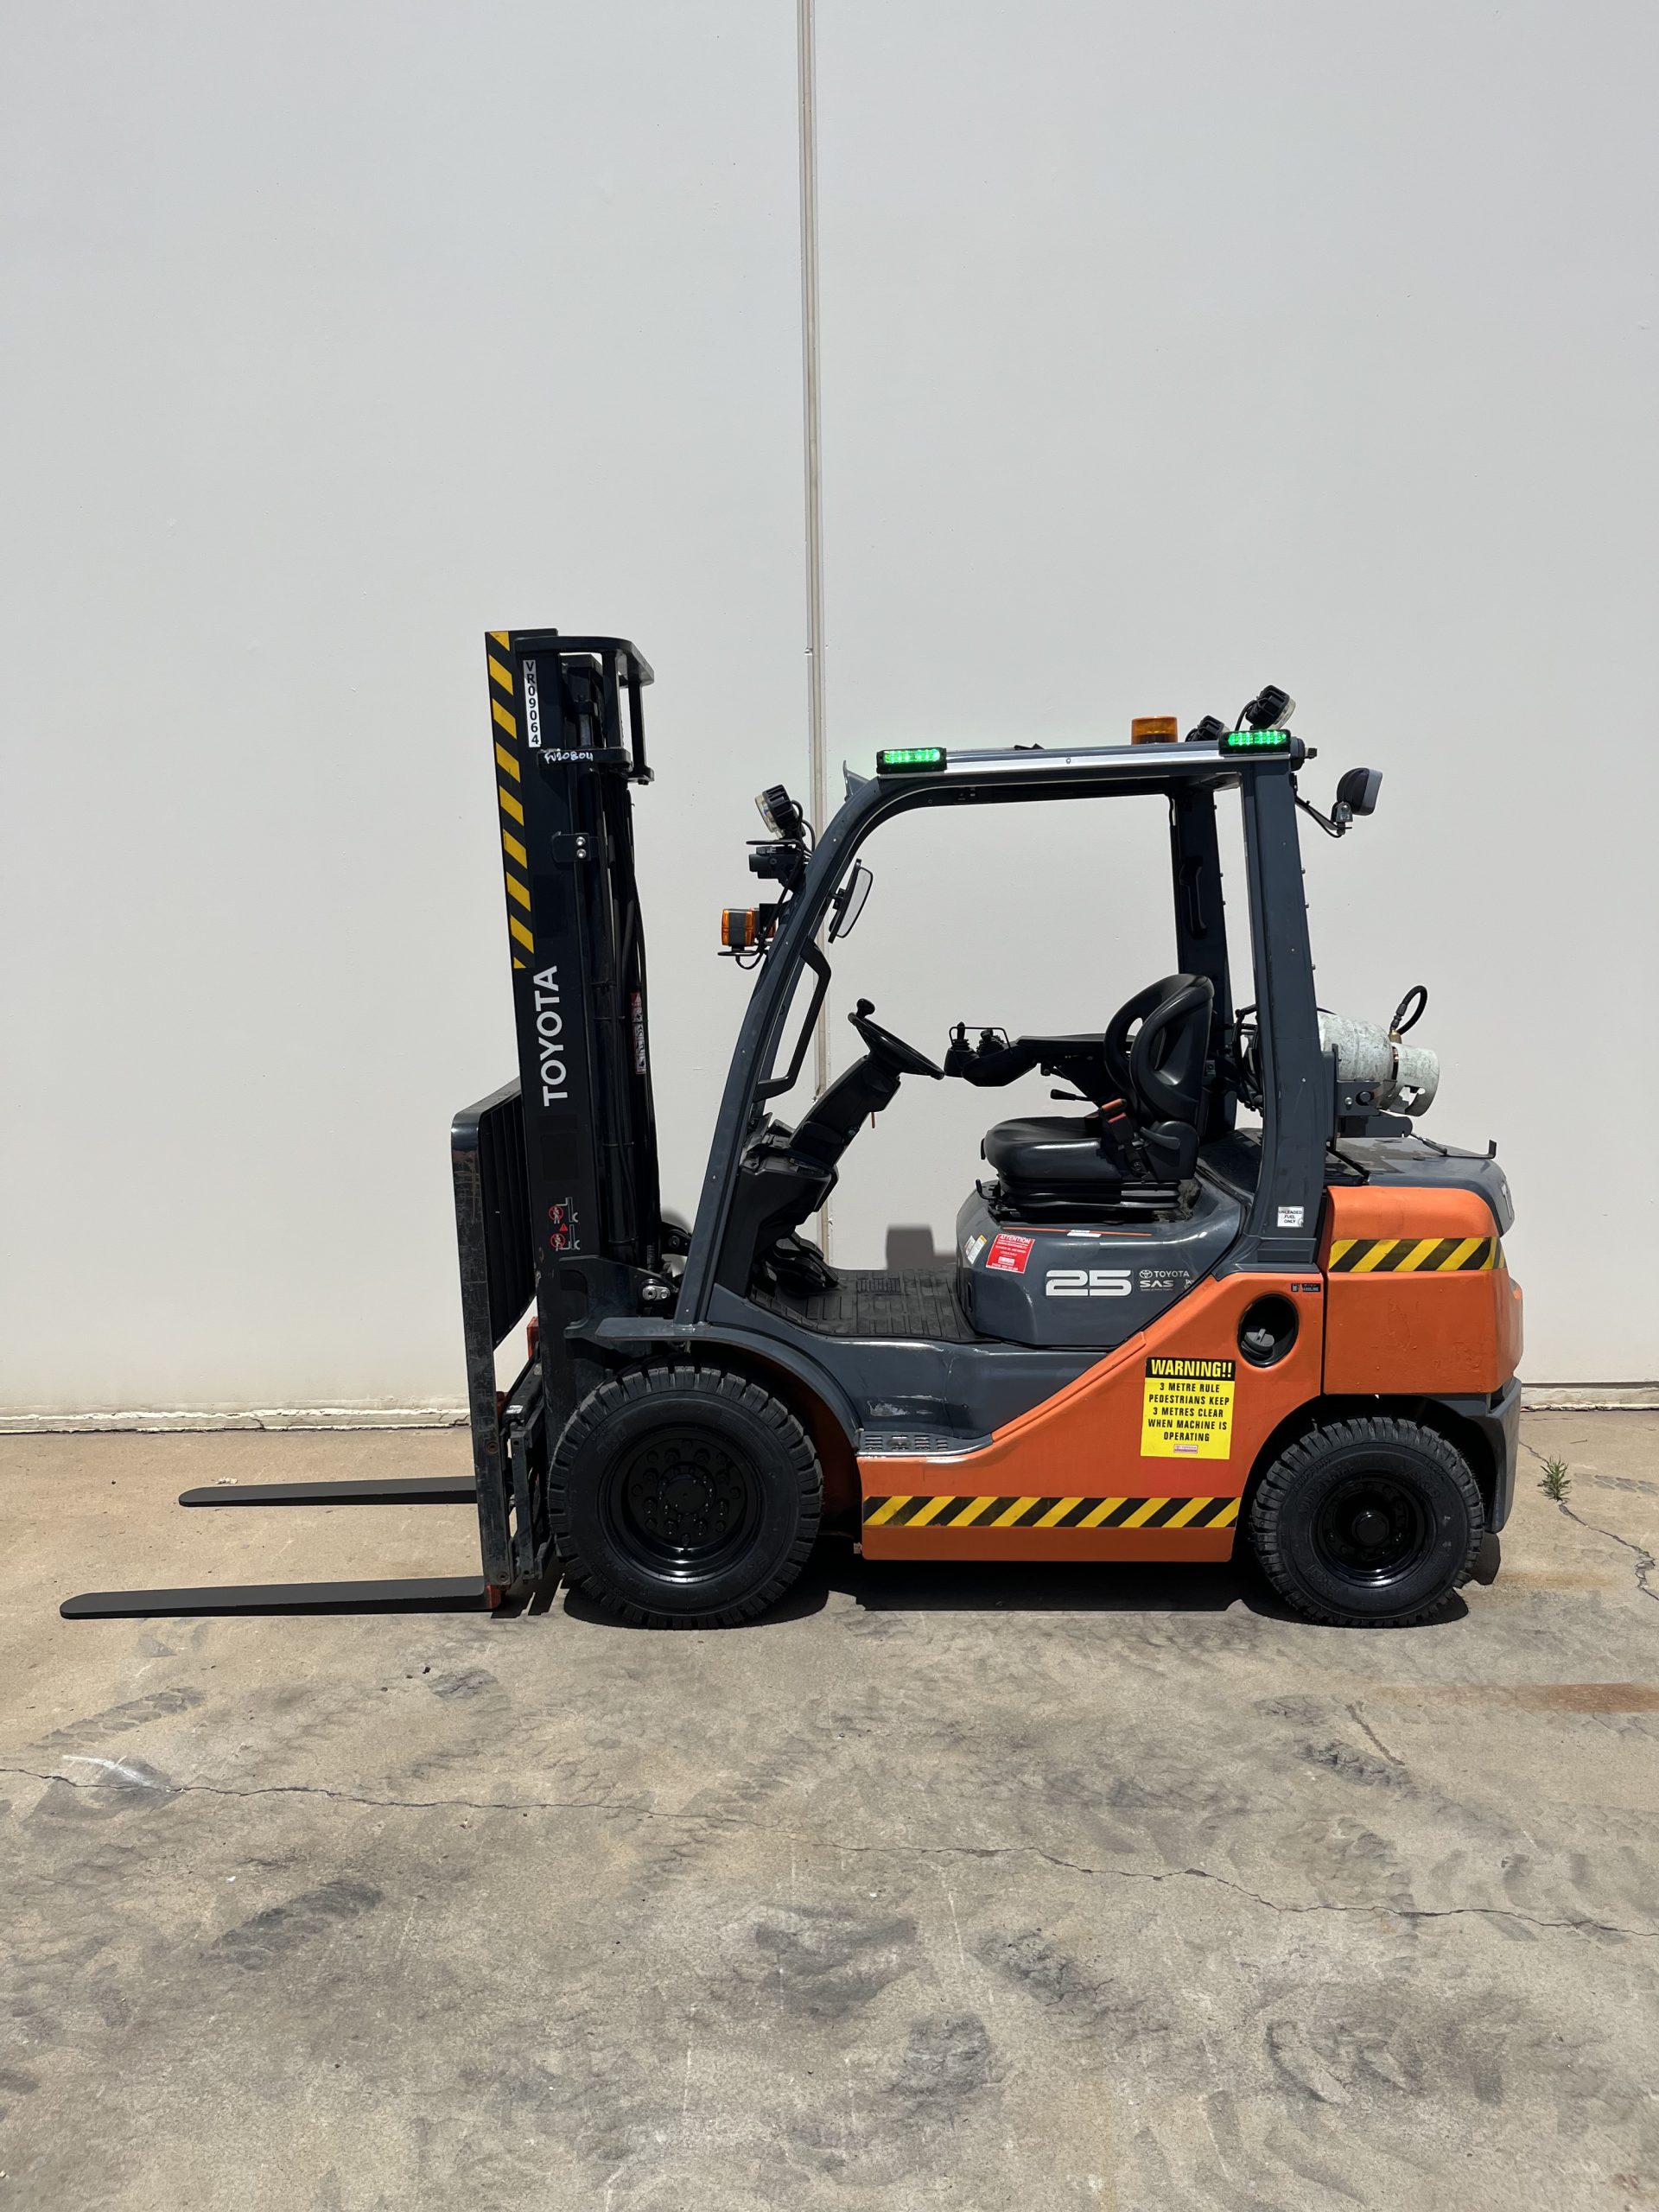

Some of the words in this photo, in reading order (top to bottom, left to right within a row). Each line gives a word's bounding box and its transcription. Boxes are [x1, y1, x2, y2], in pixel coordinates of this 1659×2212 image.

[525, 661, 539, 745] VR09064
[531, 964, 568, 1107] TOYOTA
[999, 1235, 1030, 1243] ATTENTION
[1046, 1270, 1132, 1296] 25
[1151, 1359, 1232, 1377] WARNING!!
[1168, 1382, 1196, 1392] METRE
[1200, 1384, 1220, 1393] RULE
[1149, 1395, 1205, 1404] PEDESTRIANS
[1162, 1408, 1194, 1416] METRES
[1198, 1408, 1224, 1417] CLEAR
[1148, 1419, 1173, 1427] WHEN
[1177, 1421, 1215, 1429] MACHINE
[1164, 1432, 1210, 1441] OPERATING
